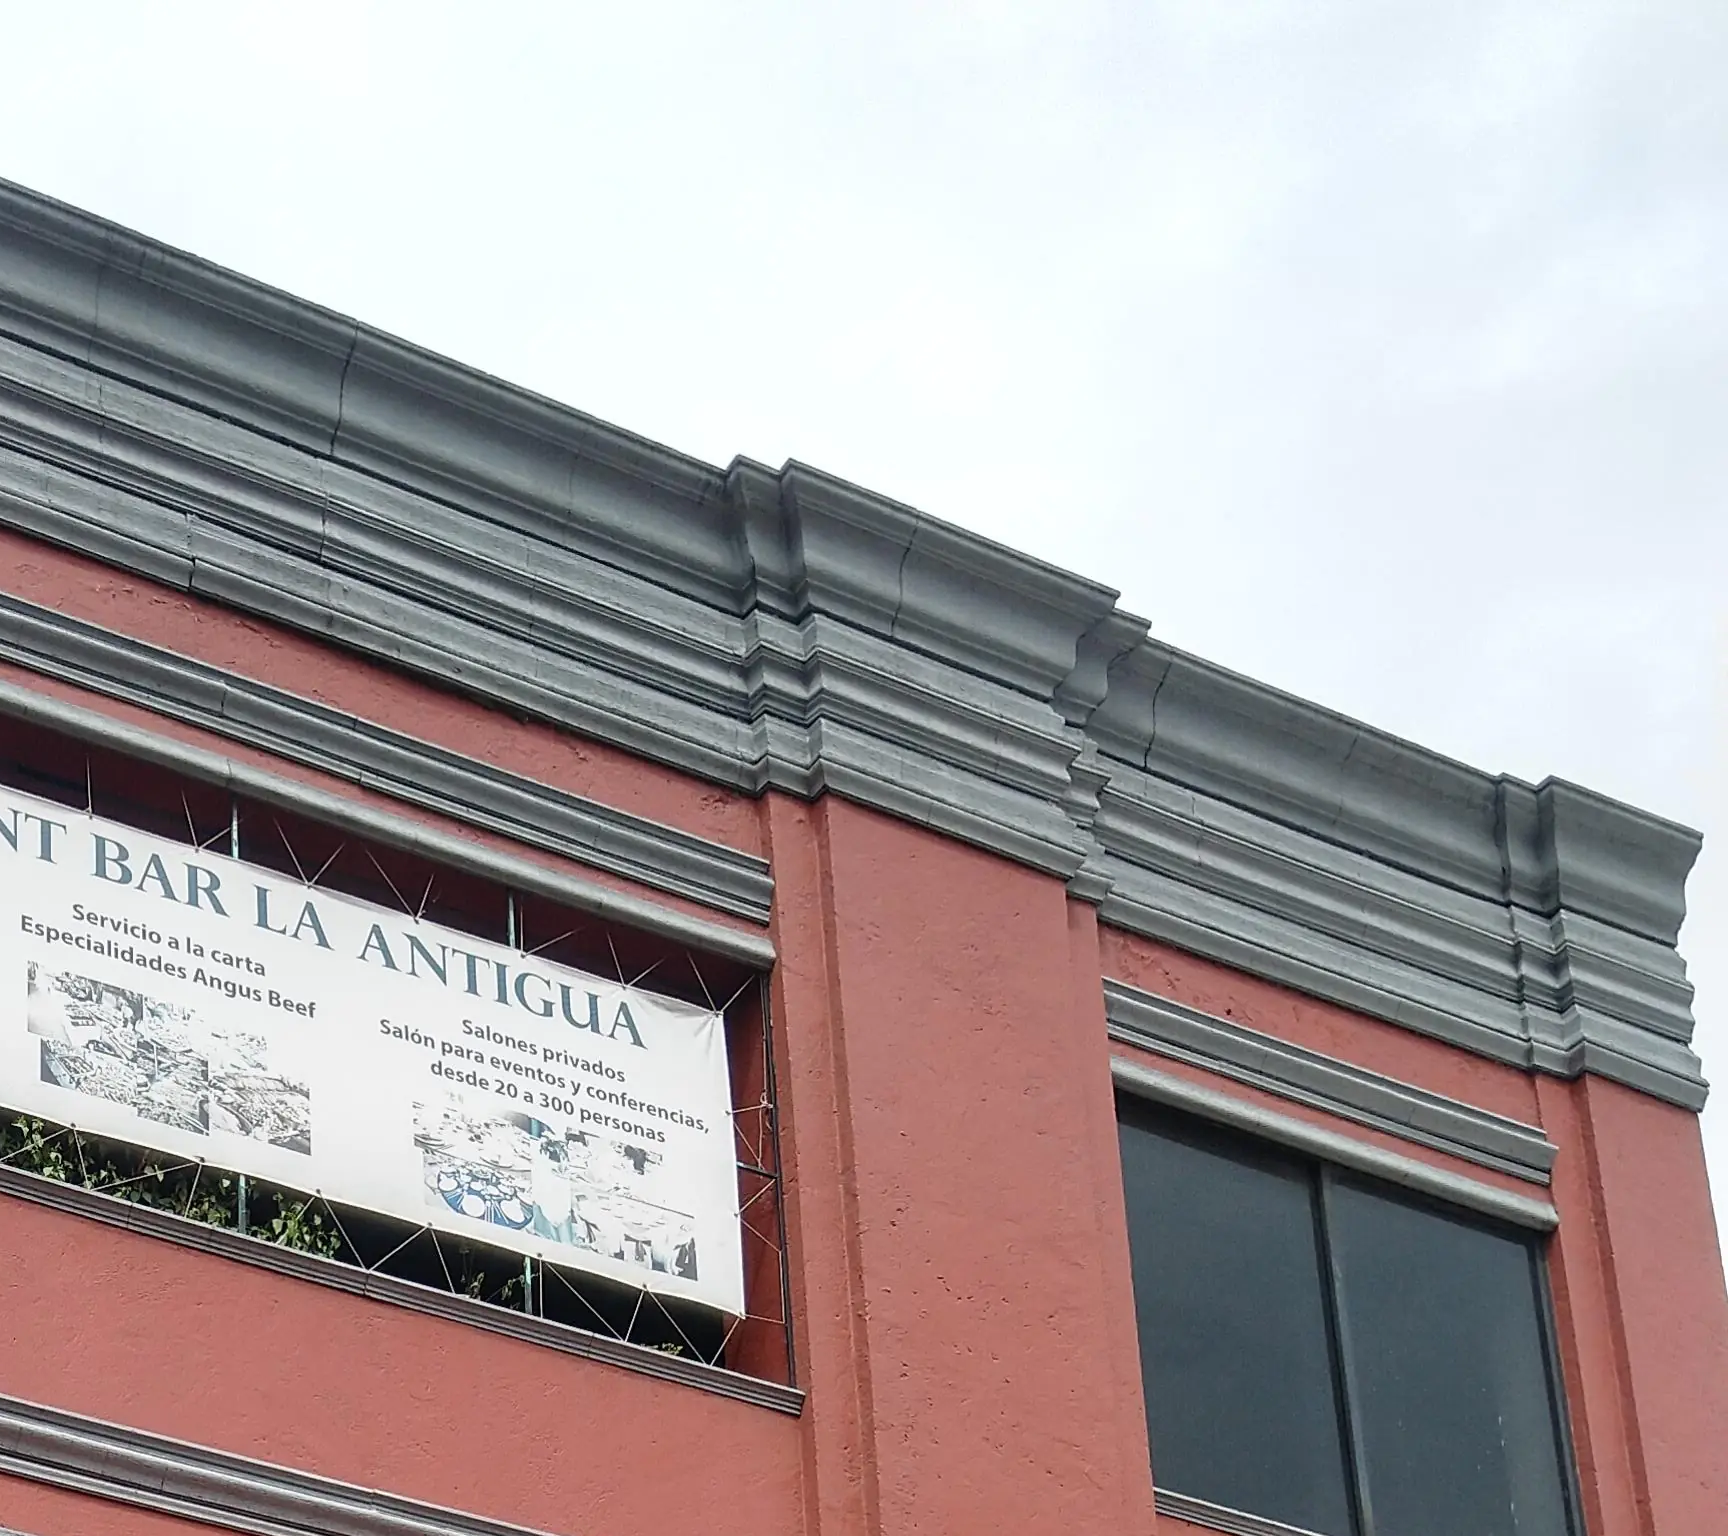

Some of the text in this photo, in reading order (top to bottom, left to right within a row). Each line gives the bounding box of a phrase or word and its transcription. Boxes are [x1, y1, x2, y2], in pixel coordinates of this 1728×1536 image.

[22, 915, 316, 1018] Especialidades Angus Beef
[73, 904, 265, 976] Servicio a la carta
[91, 833, 230, 917] BAR
[254, 885, 335, 950] LA
[358, 924, 647, 1049] ANTIGUA
[380, 1019, 709, 1133] Salón para eventos y conferencias,
[463, 1020, 625, 1082] Salones privados
[431, 1060, 666, 1142] desde 20 a 300 personas
